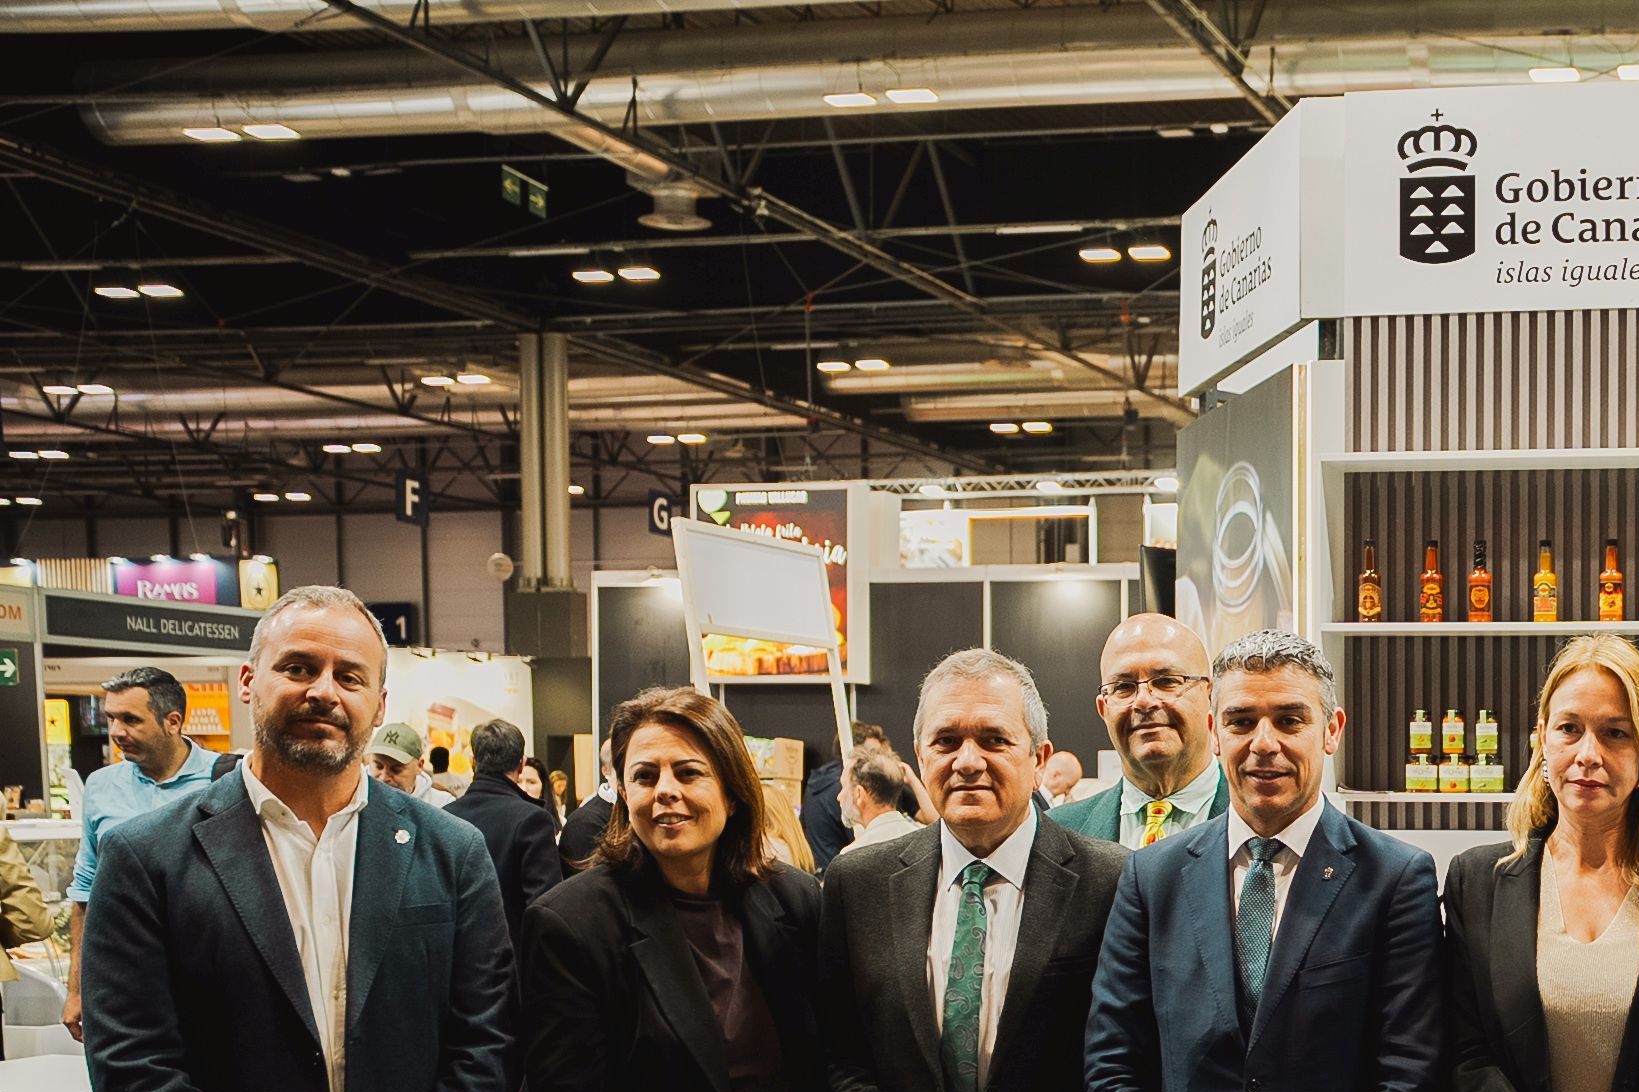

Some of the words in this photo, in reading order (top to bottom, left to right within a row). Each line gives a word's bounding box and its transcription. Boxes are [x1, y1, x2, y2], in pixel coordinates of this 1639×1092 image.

[1495, 212, 1542, 246] de
[1220, 226, 1262, 277] Gobierno
[1219, 284, 1230, 314] de
[1231, 255, 1272, 305] Canarias
[1496, 260, 1553, 284] islas
[404, 478, 420, 517] F
[652, 496, 669, 531] G
[126, 615, 158, 634] NALL
[160, 618, 239, 640] DELICATESSEN
